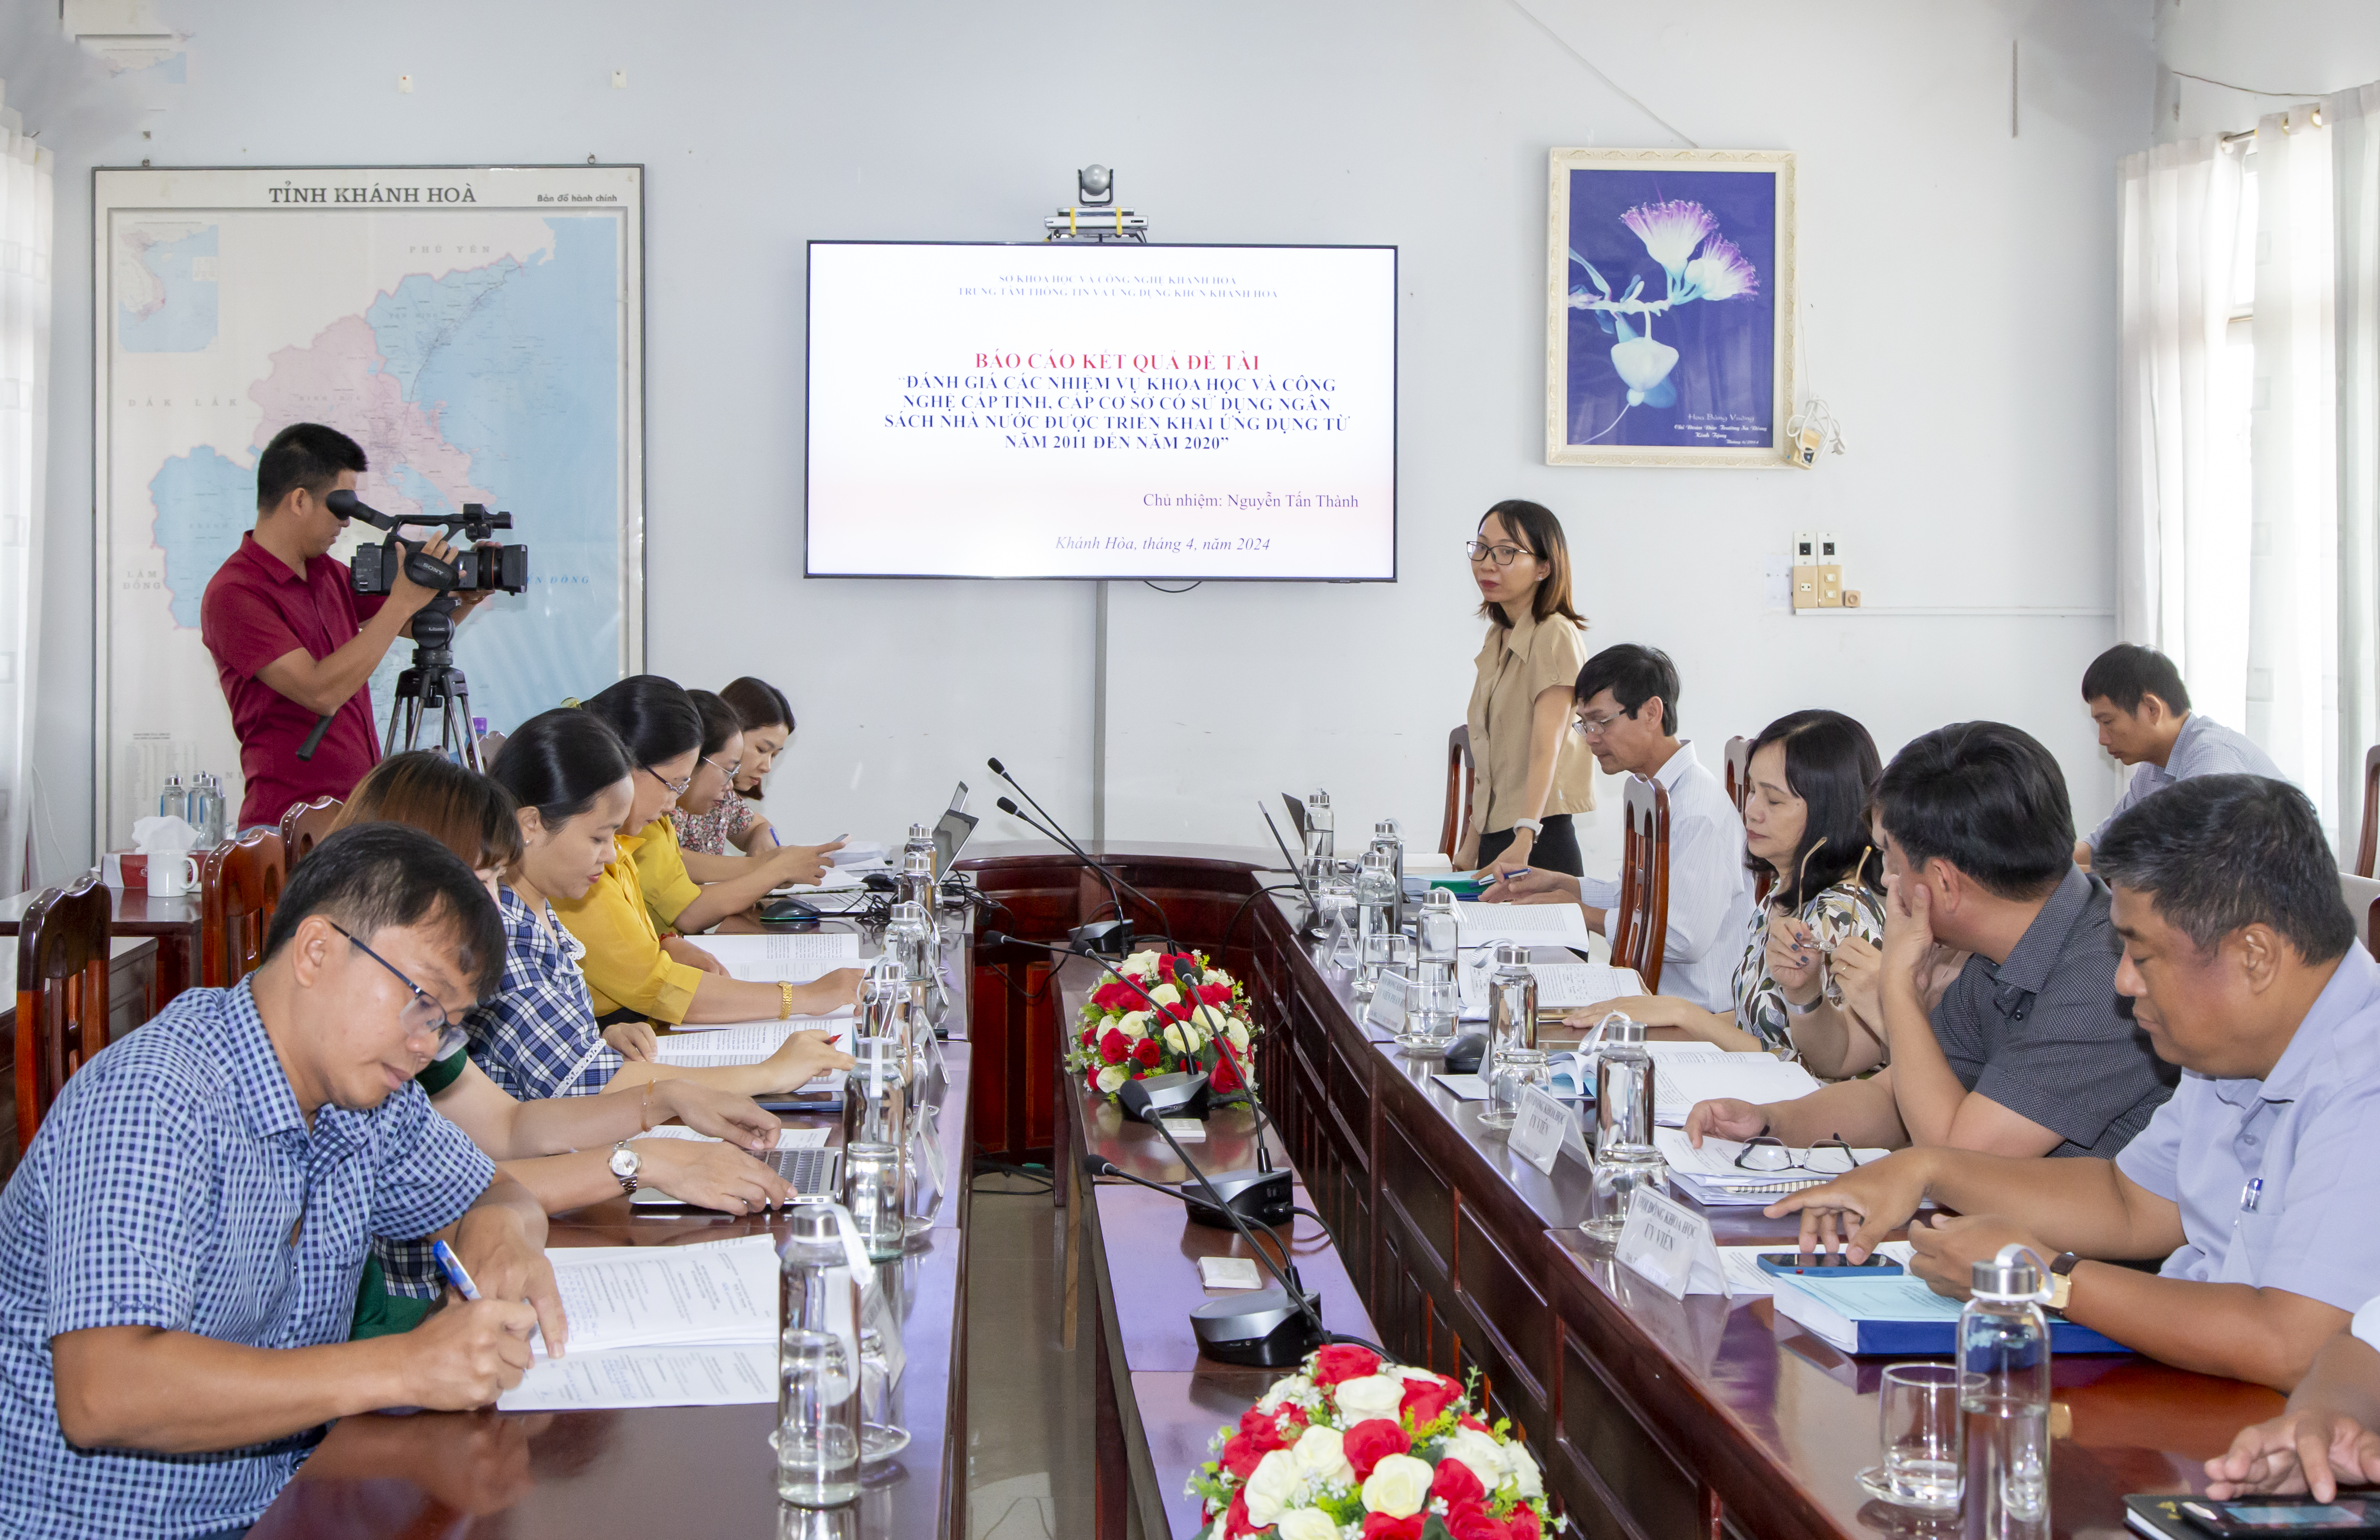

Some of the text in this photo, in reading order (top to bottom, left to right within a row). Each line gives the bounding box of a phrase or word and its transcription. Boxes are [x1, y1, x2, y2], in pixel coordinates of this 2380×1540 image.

[269, 180, 476, 203] TỈNH KHÁNH HOÀ
[1017, 275, 1050, 283] KHOA
[1052, 275, 1077, 285] HỌC
[1080, 274, 1095, 284] VÀ
[1098, 273, 1130, 284] CÔNG
[1169, 274, 1209, 285] KHÁNH
[958, 287, 997, 296] TRUNG
[999, 285, 1026, 296] TÂM
[1028, 285, 1068, 297] THÔNG
[1072, 287, 1089, 297] TIN
[1093, 286, 1108, 297] VÀ
[1140, 288, 1171, 299] DỤNG
[1174, 289, 1206, 298] KHCN
[1210, 287, 1250, 298] KHÁNH
[976, 349, 1259, 373] BÁO CÁO KẾT QUẢ ĐỀ TÀI
[965, 373, 998, 389] GIÁ
[1004, 373, 1042, 389] CÁC
[1048, 374, 1110, 393] NHIỆM
[1116, 377, 1140, 393] VỤ
[1147, 377, 1201, 391] KHOA
[1207, 378, 1246, 394] HỌC
[1252, 375, 1277, 391] VÀ
[1283, 375, 1336, 392] CÔNG
[903, 392, 1331, 414] NGHỆ CẤP TỈNH, CẤP CƠ SỞ CÓ SỬ DỤNG NGÂN
[884, 411, 1351, 434] SÁCH NHÀ NƯỚC ĐƯỢC TRIỂN KHAI ỨNG DỤNG TỪ
[1005, 432, 1047, 449] NĂM
[1053, 436, 1085, 449] 2011
[1093, 432, 1130, 449] ĐẾN
[1136, 434, 1178, 449] NĂM
[1143, 491, 1359, 510] Chủ nhiệm: Nguyễn Tấn Thành
[1055, 536, 1271, 553] Khánh Hòa, tháng 4, năm 2024
[423, 562, 444, 576] SONY
[1664, 1210, 1681, 1232] KHOA
[1680, 1222, 1698, 1240] HỌC
[1656, 1229, 1676, 1252] VIÊN
